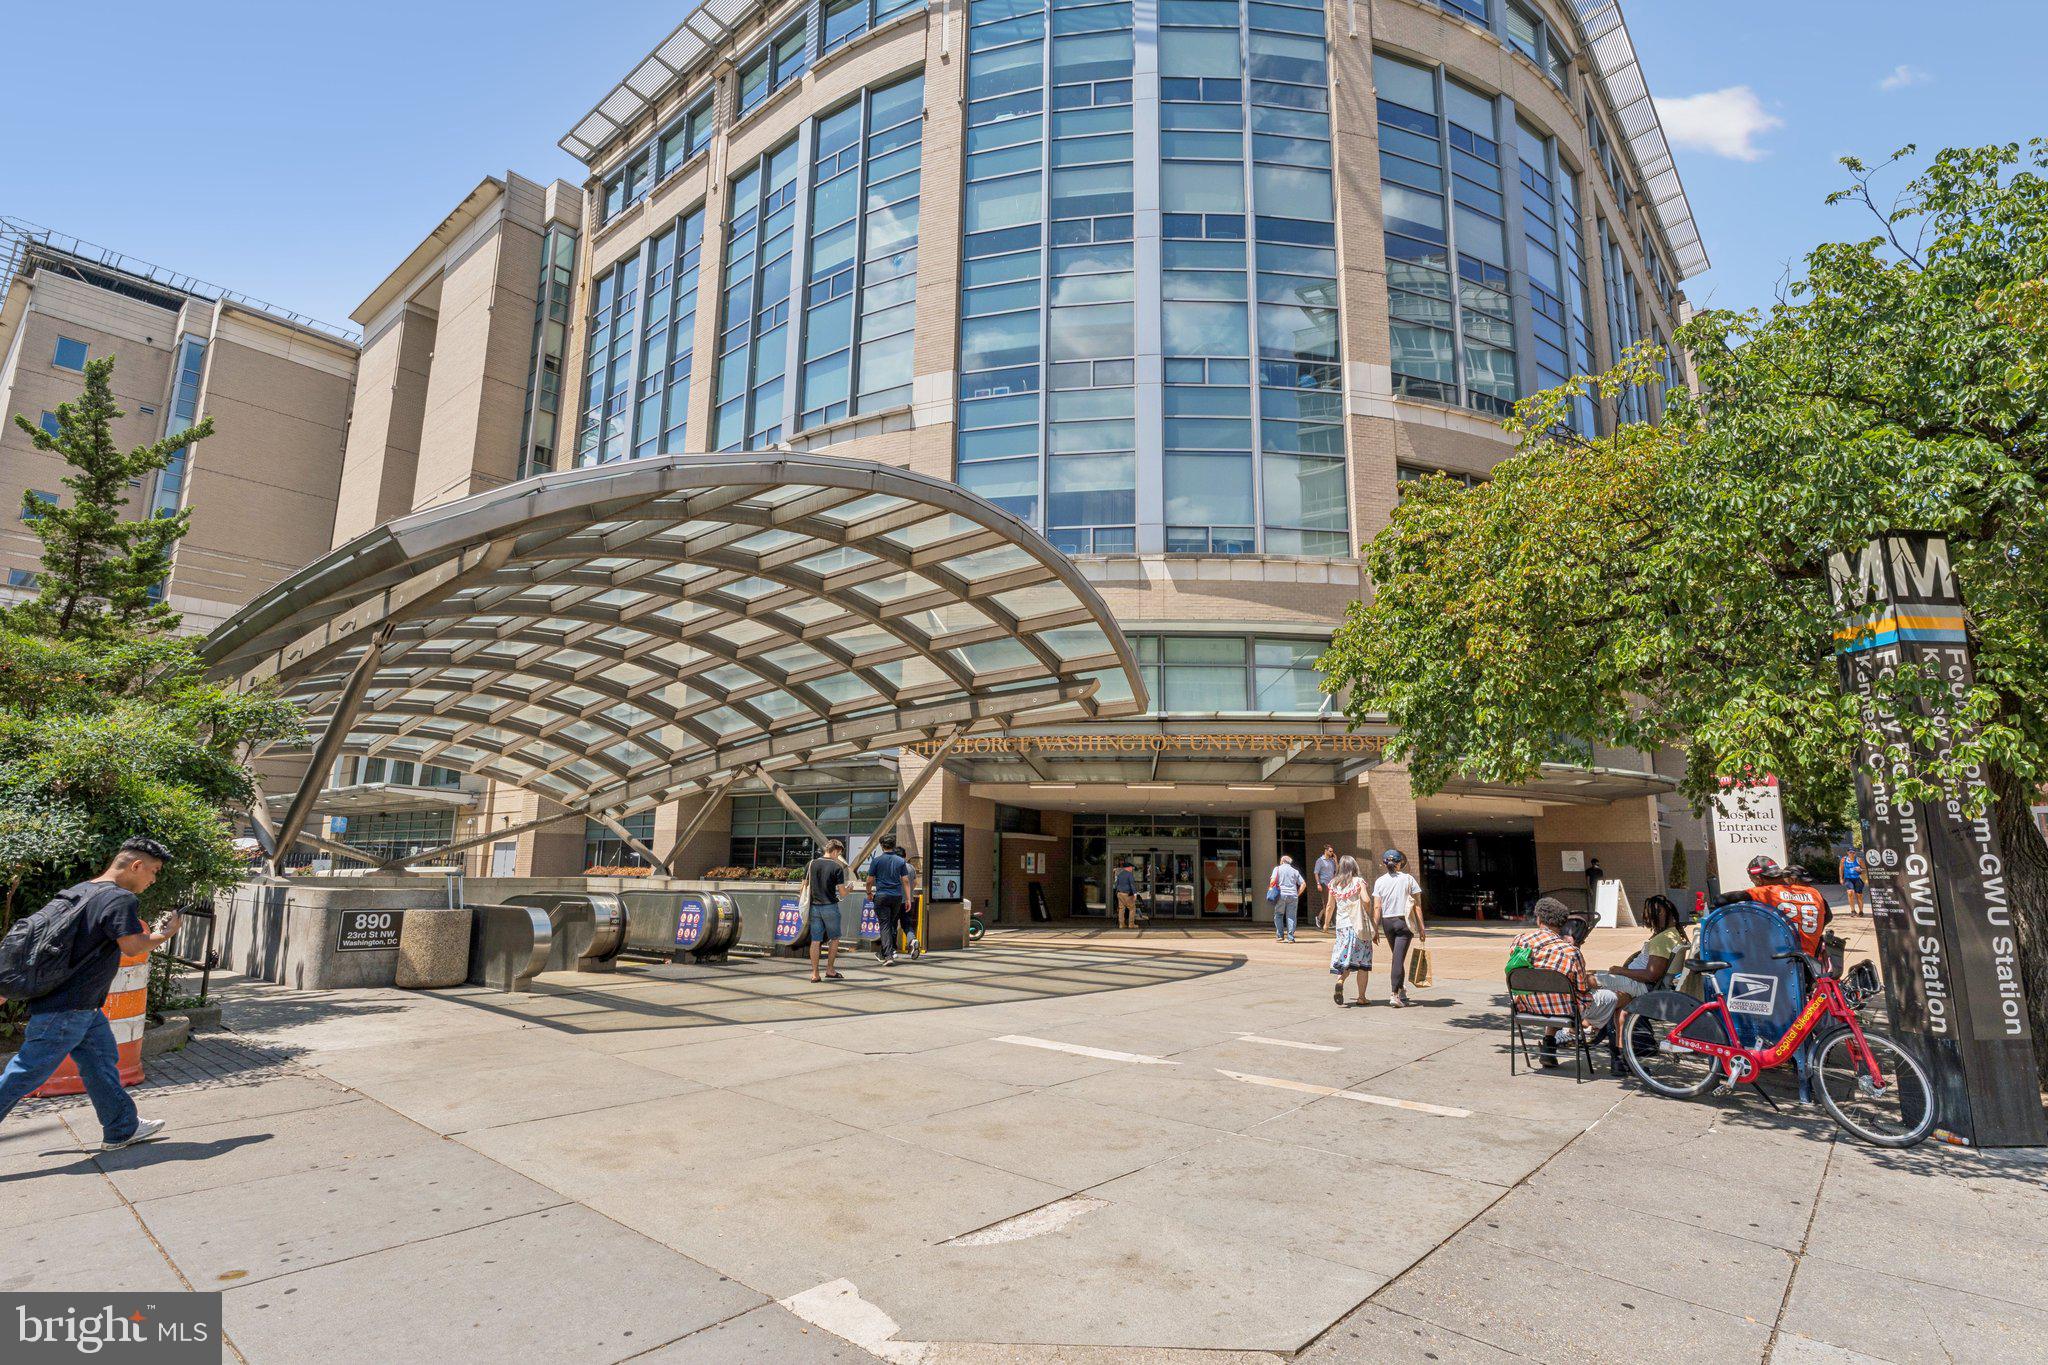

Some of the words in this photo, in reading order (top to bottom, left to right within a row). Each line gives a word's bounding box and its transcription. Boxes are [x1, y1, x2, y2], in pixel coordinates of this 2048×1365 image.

[1828, 539, 1888, 612] M
[1888, 537, 1955, 598] M
[950, 736, 1031, 754] GEORGE
[1035, 734, 1181, 751] WASHINGTON
[1190, 734, 1325, 751] UNIVERSITY
[1718, 821, 1778, 832] Entrance
[1730, 833, 1768, 844] Drive
[355, 913, 391, 930] 890
[1777, 901, 1819, 934] 28
[347, 930, 367, 939] 23rd
[380, 930, 396, 938] NW
[1918, 936, 1948, 1034] Station
[1992, 936, 2022, 1035] Station
[1776, 1028, 1798, 1056] capital
[1793, 996, 1824, 1031] bikeshare
